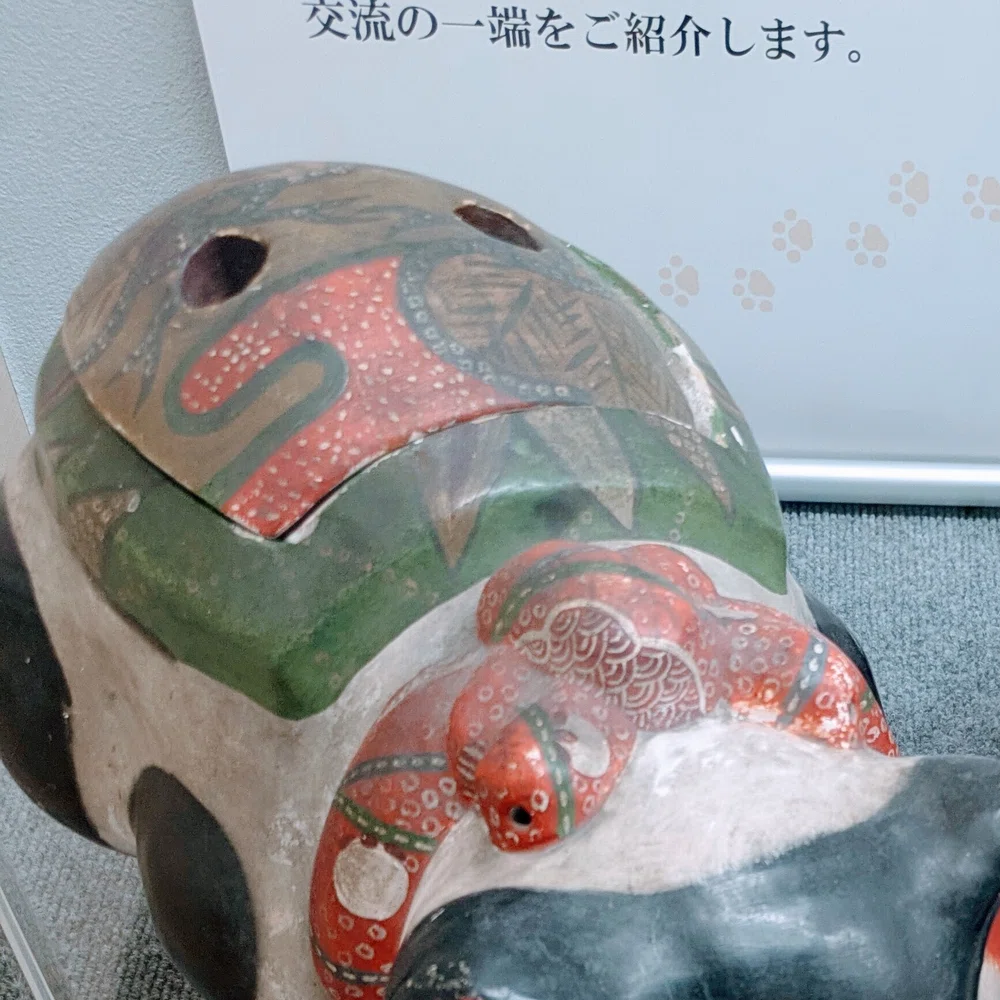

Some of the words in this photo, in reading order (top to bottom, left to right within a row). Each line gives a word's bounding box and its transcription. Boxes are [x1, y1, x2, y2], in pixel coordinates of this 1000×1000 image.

[305, 0, 862, 64] 交流の一端をご紹介します。
